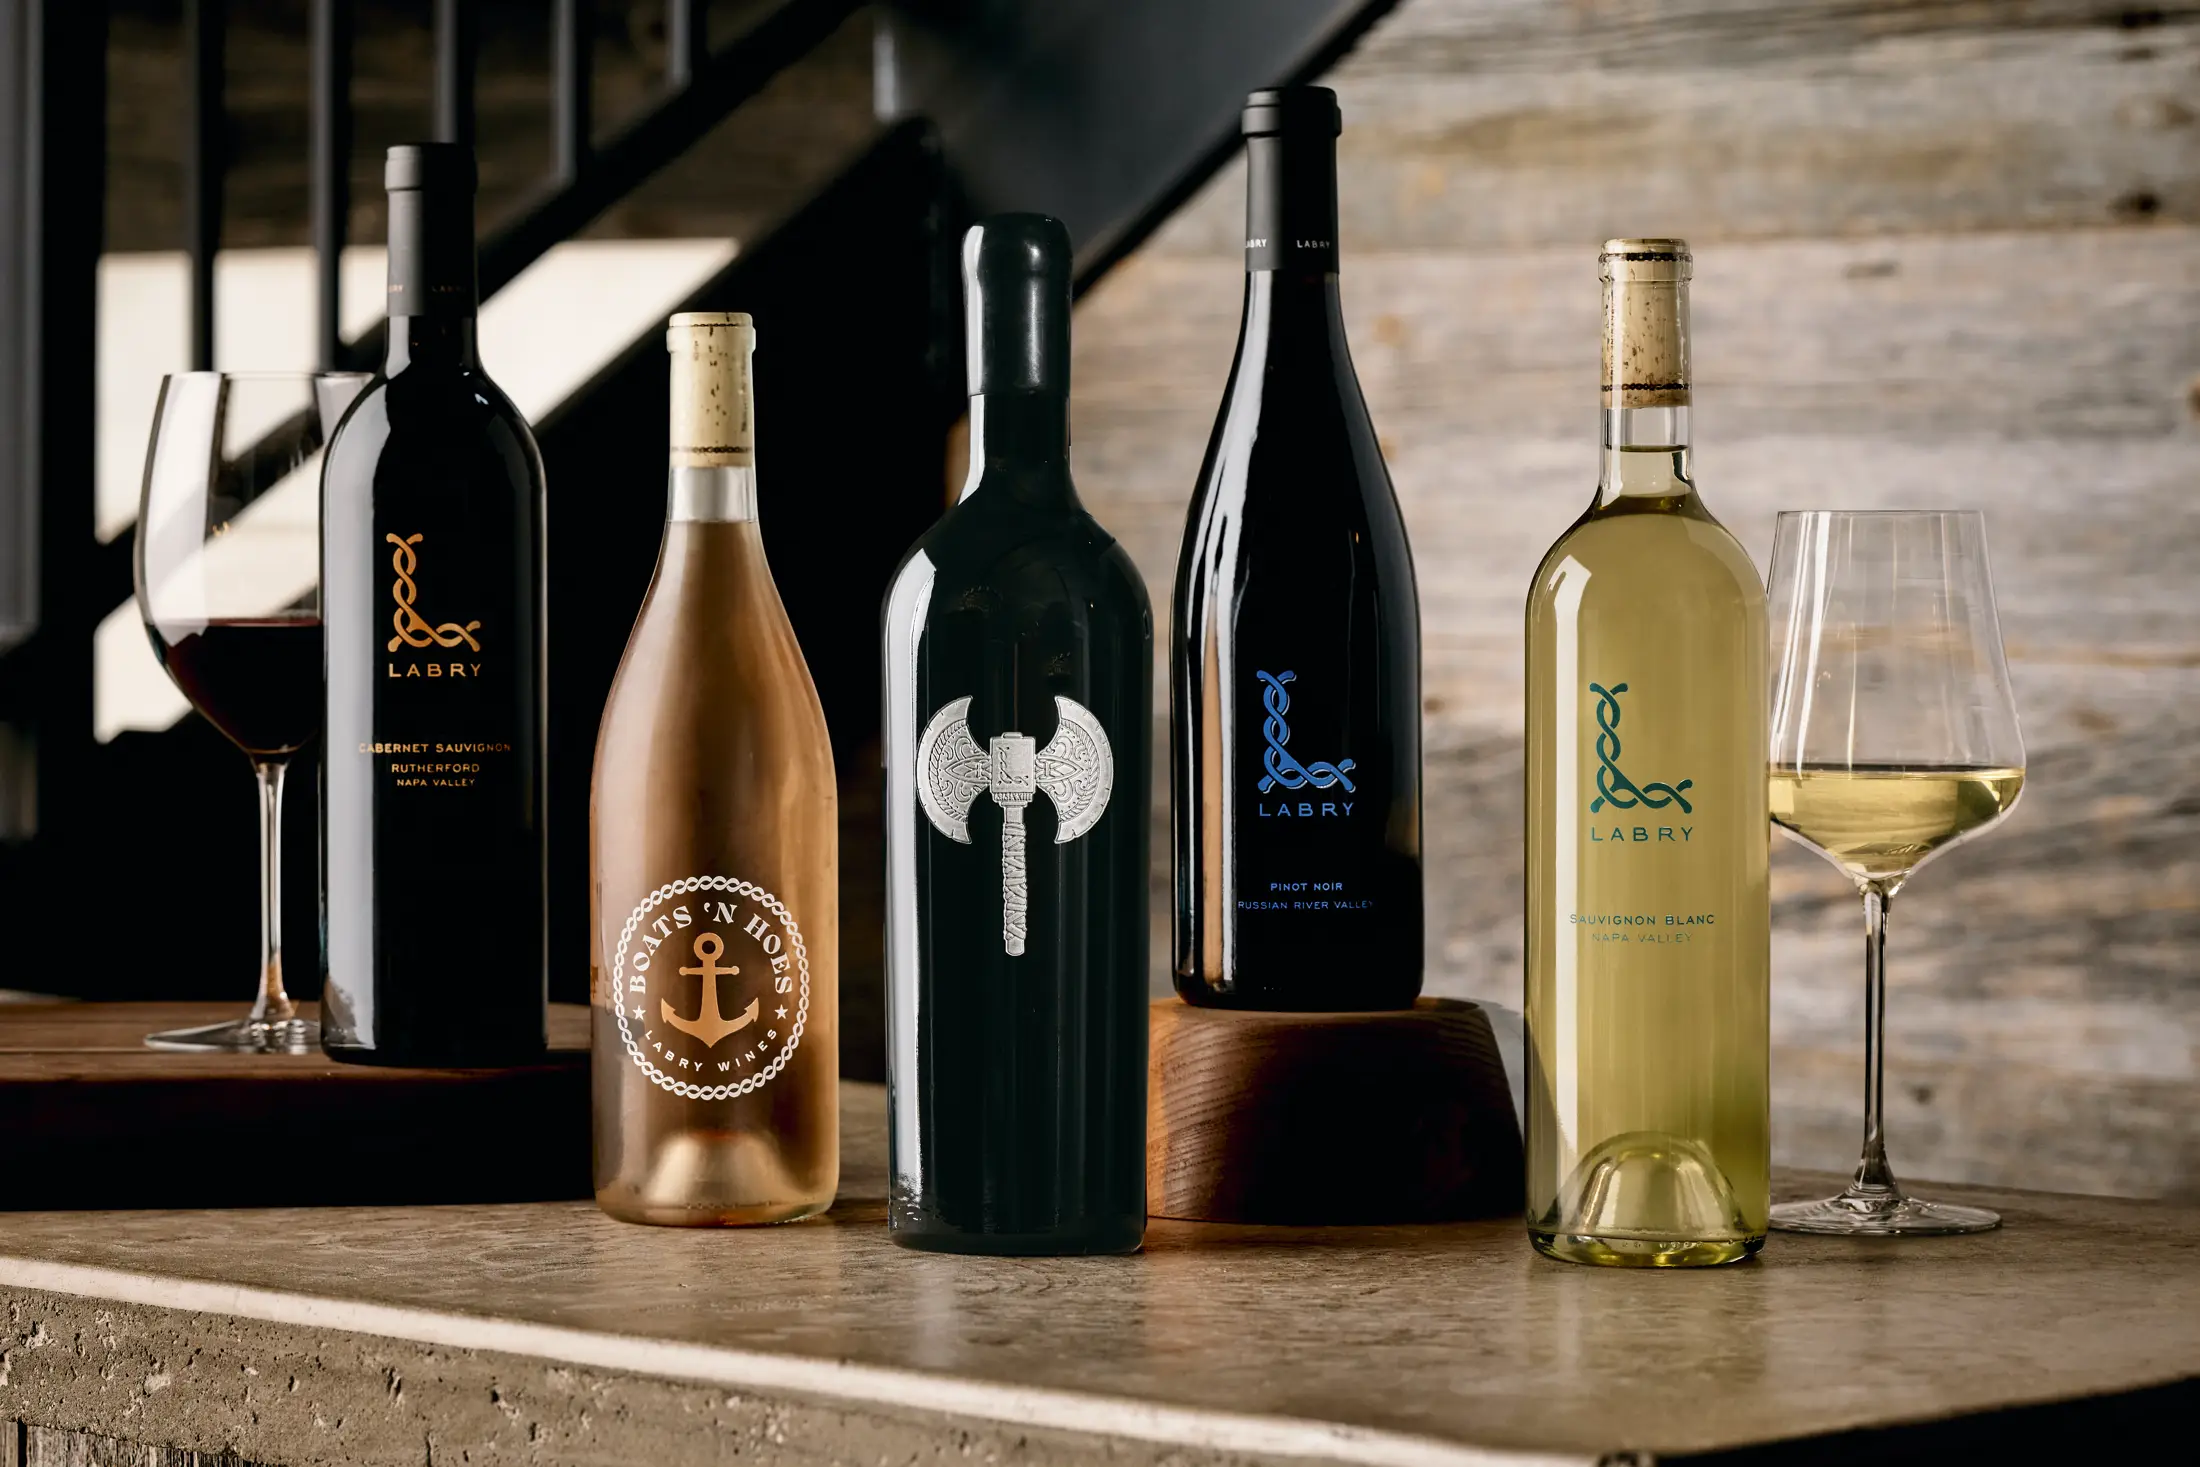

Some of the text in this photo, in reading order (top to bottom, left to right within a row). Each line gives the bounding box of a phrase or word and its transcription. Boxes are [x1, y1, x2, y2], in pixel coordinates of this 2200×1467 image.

[1297, 239, 1330, 249] LABRY
[388, 663, 481, 678] LABRY
[359, 743, 511, 753] CABERNET SAUVIGNON
[391, 763, 480, 773] RUTHERFORD
[397, 778, 476, 787] NAPA VALLEY
[1259, 802, 1354, 817] LABRY
[1591, 826, 1693, 842] LABRY
[1270, 882, 1343, 892] PINOT NOIR
[1238, 901, 1288, 910] RUSSIAN
[1294, 901, 1329, 910] RIVER
[1569, 913, 1715, 925] SAUVIGNON BLANC
[1592, 933, 1693, 943] NAPA VALLEY
[629, 905, 693, 995] BOATS
[743, 913, 793, 994] HOES
[645, 1029, 777, 1072] LABRY WINES
